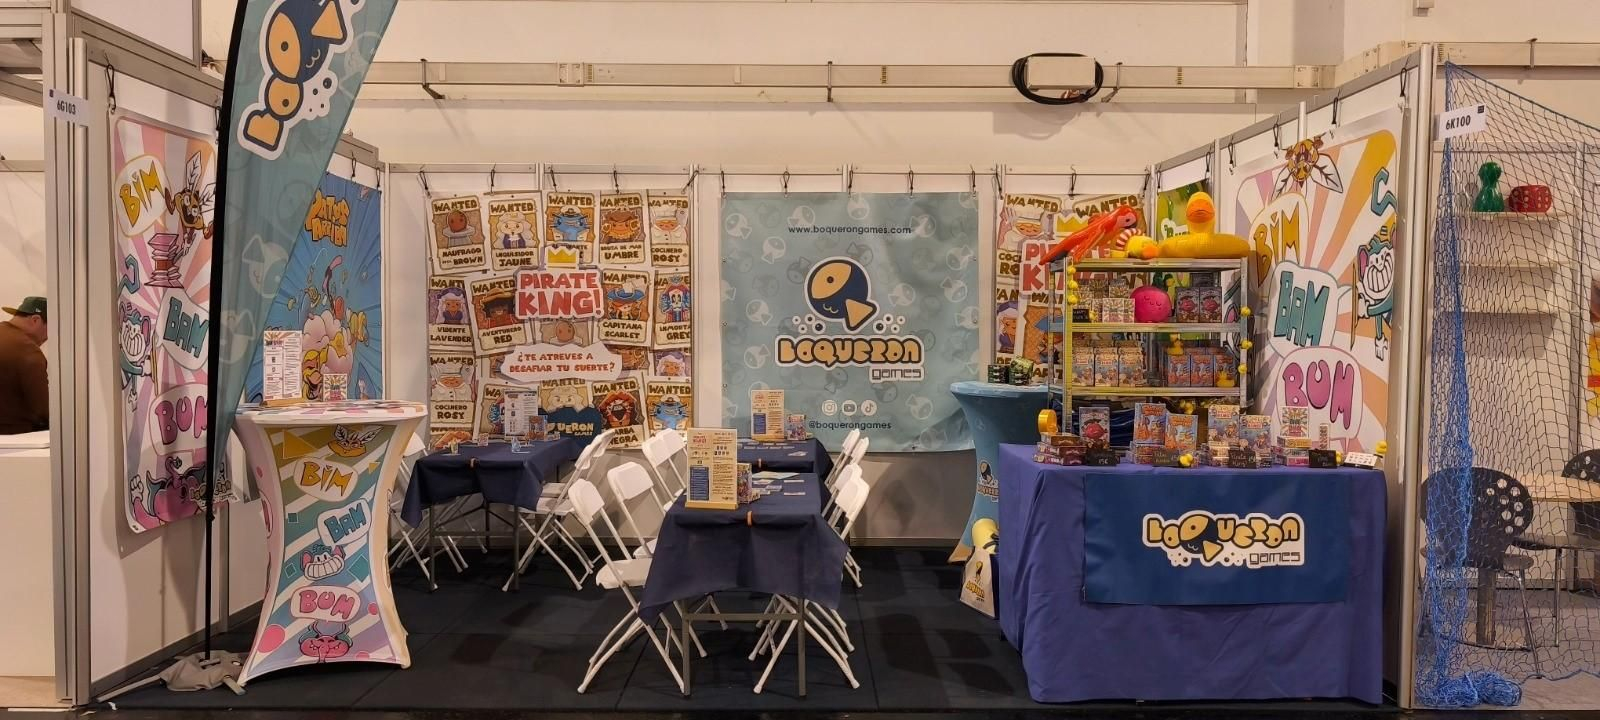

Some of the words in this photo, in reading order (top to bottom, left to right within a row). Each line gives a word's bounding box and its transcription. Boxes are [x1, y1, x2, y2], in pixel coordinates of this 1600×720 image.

[57, 100, 76, 115] 6G103
[1446, 115, 1471, 130] 6K100
[433, 199, 478, 212] WANTED
[549, 195, 592, 206] WANTED
[490, 202, 534, 213] WANTED
[788, 225, 912, 235] www.boquerongames.com
[604, 250, 639, 260] UMBRE
[652, 254, 681, 263] ROSY
[453, 256, 483, 265] BROWN
[498, 257, 532, 267] JAUNE
[431, 279, 465, 288] WANT
[520, 272, 598, 290] PIRATE
[518, 290, 601, 316] KING!
[1274, 270, 1330, 347] BAM
[163, 296, 209, 360] BAM
[437, 326, 466, 334] VIDENTE
[602, 321, 643, 330] CAPITANA
[481, 326, 522, 337] AVENTURERO
[604, 330, 641, 339] SCARLET
[666, 331, 691, 340] GREY
[430, 334, 472, 343] LAVENDER
[493, 335, 513, 344] RED
[539, 353, 583, 361] ATREVES
[586, 352, 594, 361] A
[509, 364, 552, 373] DESAFIAR
[556, 364, 570, 372] TU
[574, 361, 616, 373] SUERTE?
[593, 381, 637, 394] WANTED
[649, 385, 691, 395] WANTED
[1282, 359, 1355, 430] BUM
[437, 411, 465, 420] ROSY
[808, 420, 892, 431] @boquerongames
[614, 427, 635, 435] ARBA
[323, 502, 367, 544] BAM
[298, 589, 356, 620] BUM
